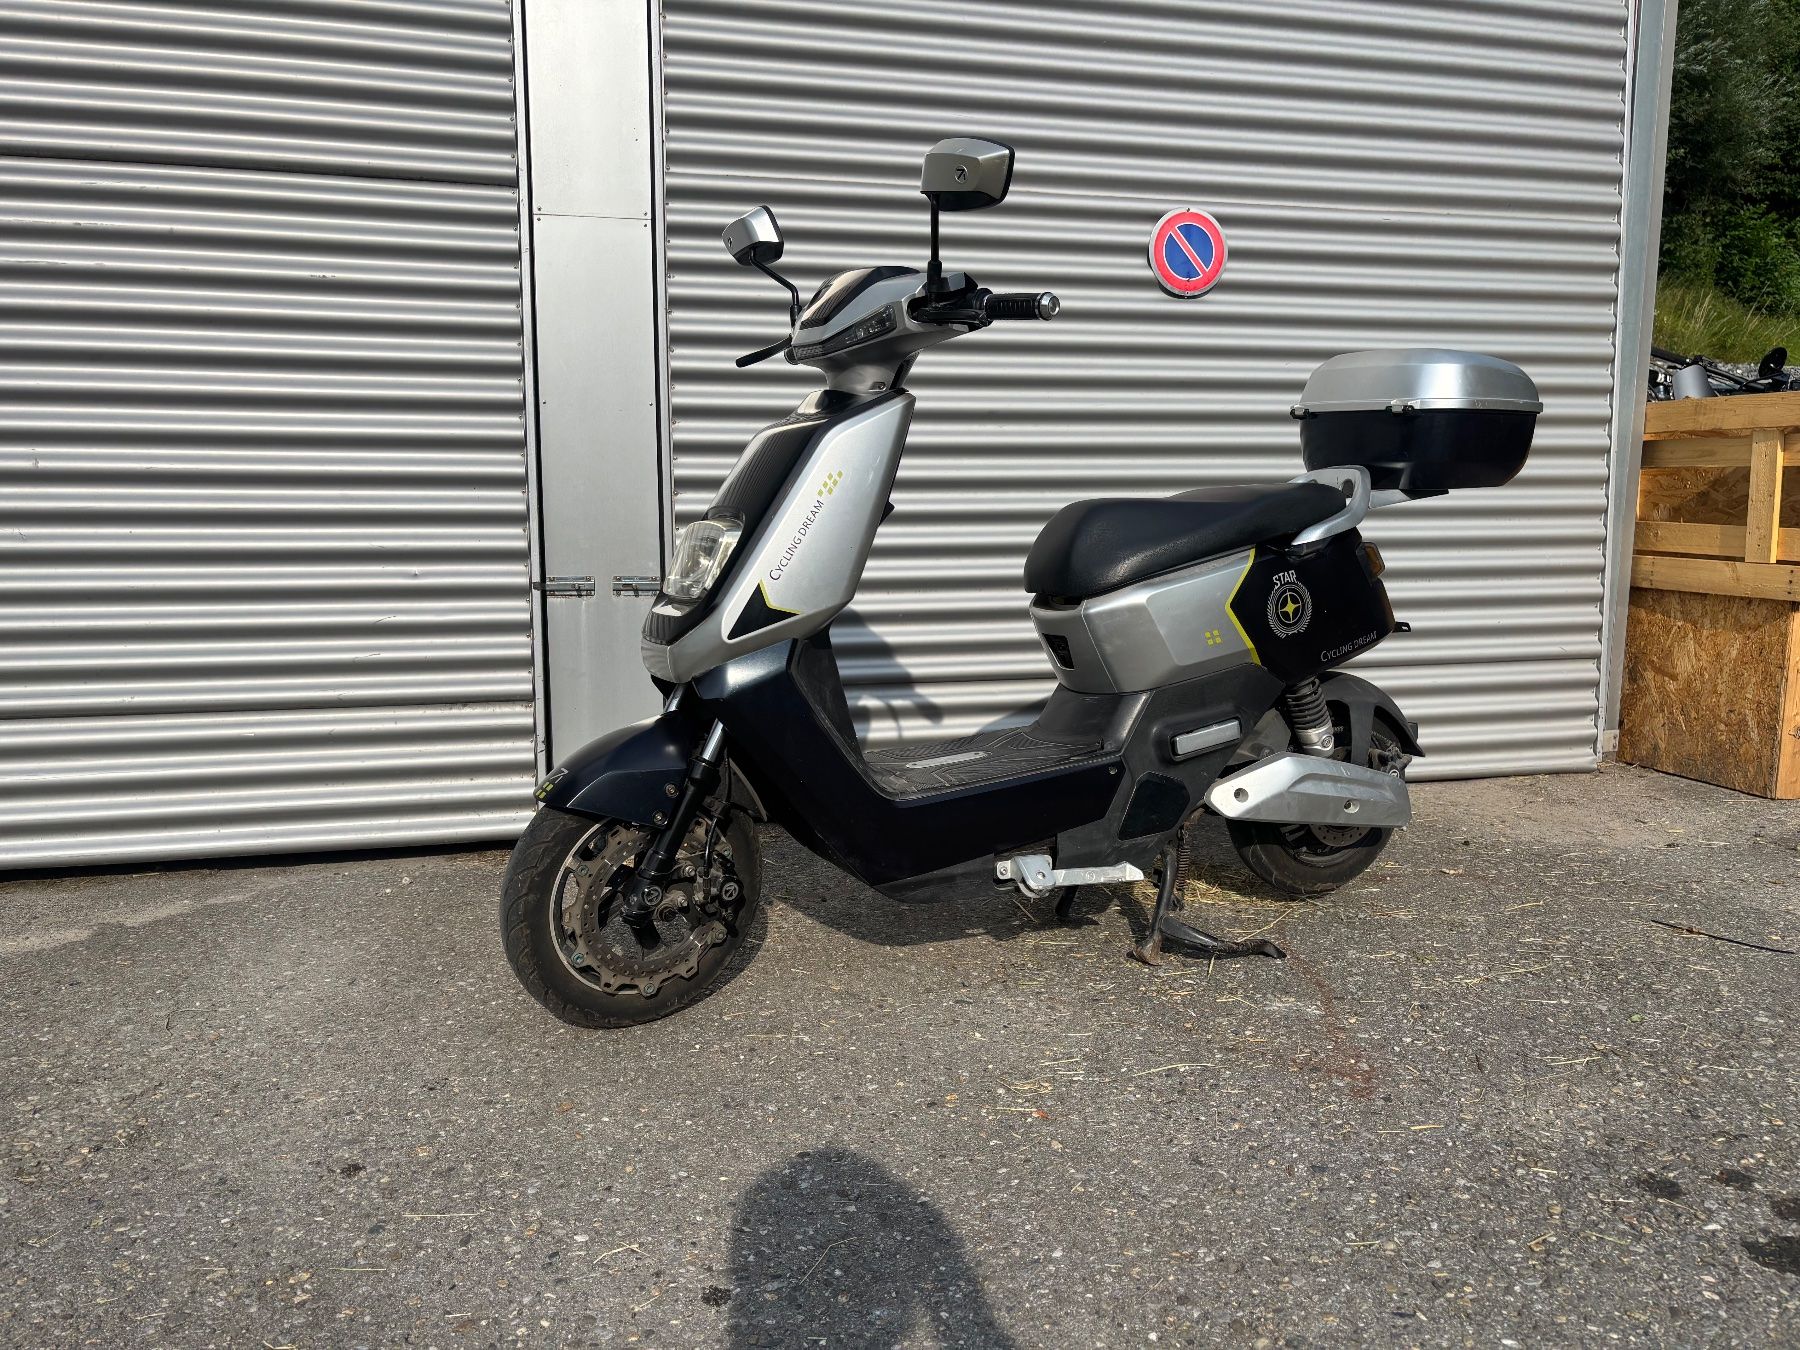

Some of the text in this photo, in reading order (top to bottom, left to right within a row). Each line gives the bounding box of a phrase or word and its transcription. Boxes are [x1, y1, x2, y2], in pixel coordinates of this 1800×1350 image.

[797, 499, 825, 537] DREAM
[1272, 569, 1298, 588] STAR
[1354, 630, 1378, 649] DREAM
